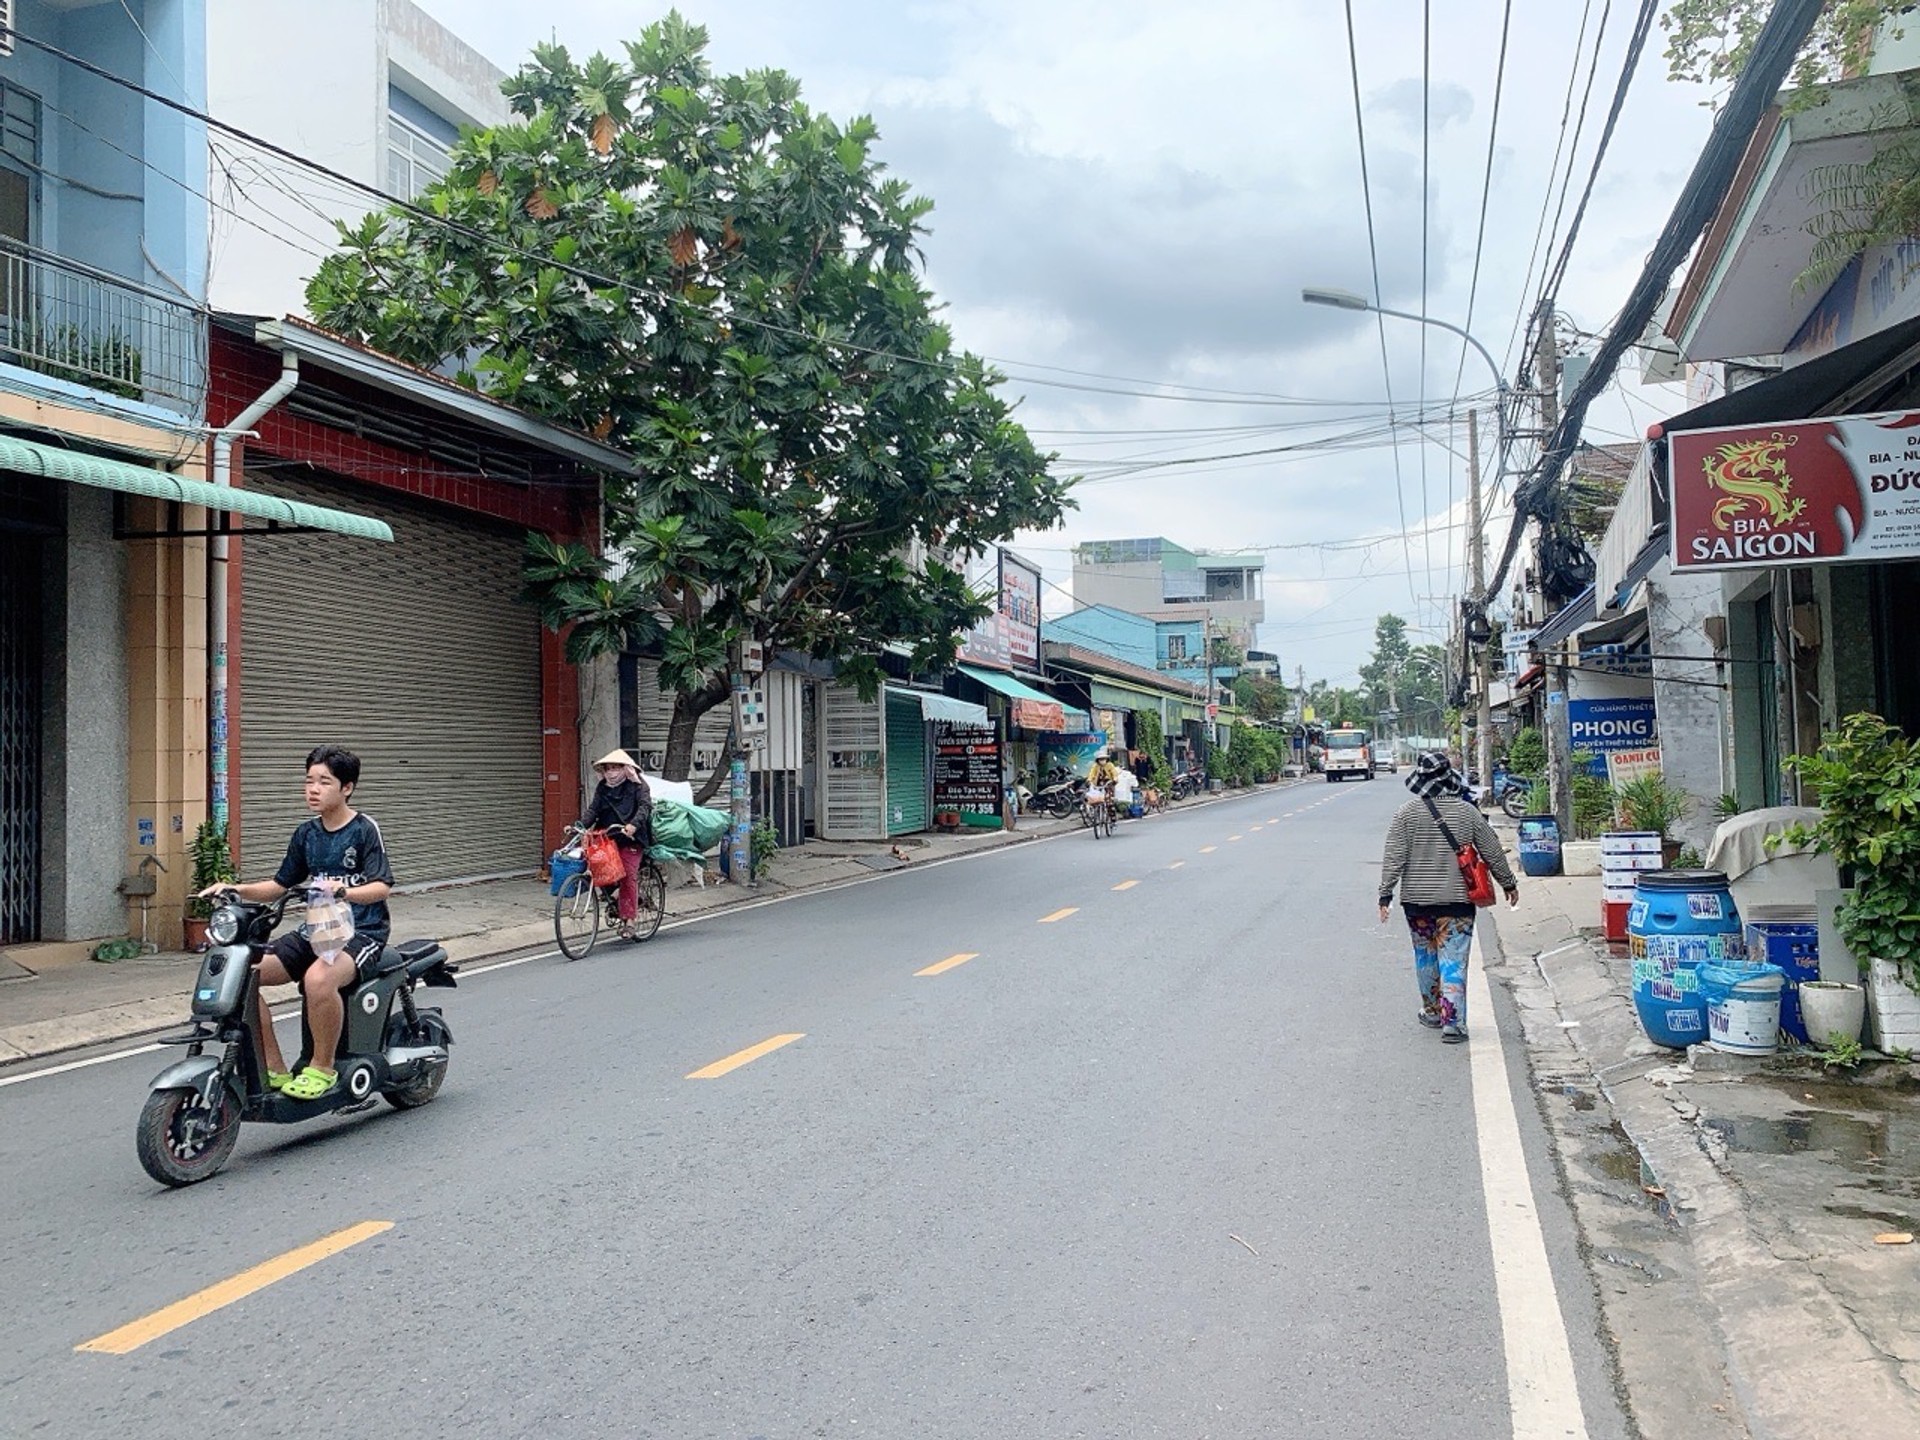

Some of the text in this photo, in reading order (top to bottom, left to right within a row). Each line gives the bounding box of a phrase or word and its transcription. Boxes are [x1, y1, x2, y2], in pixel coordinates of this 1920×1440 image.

[1869, 452, 1892, 464] BIA
[1733, 517, 1771, 534] BIA
[1691, 530, 1815, 560] SAIGON
[1571, 719, 1647, 738] PHONG
